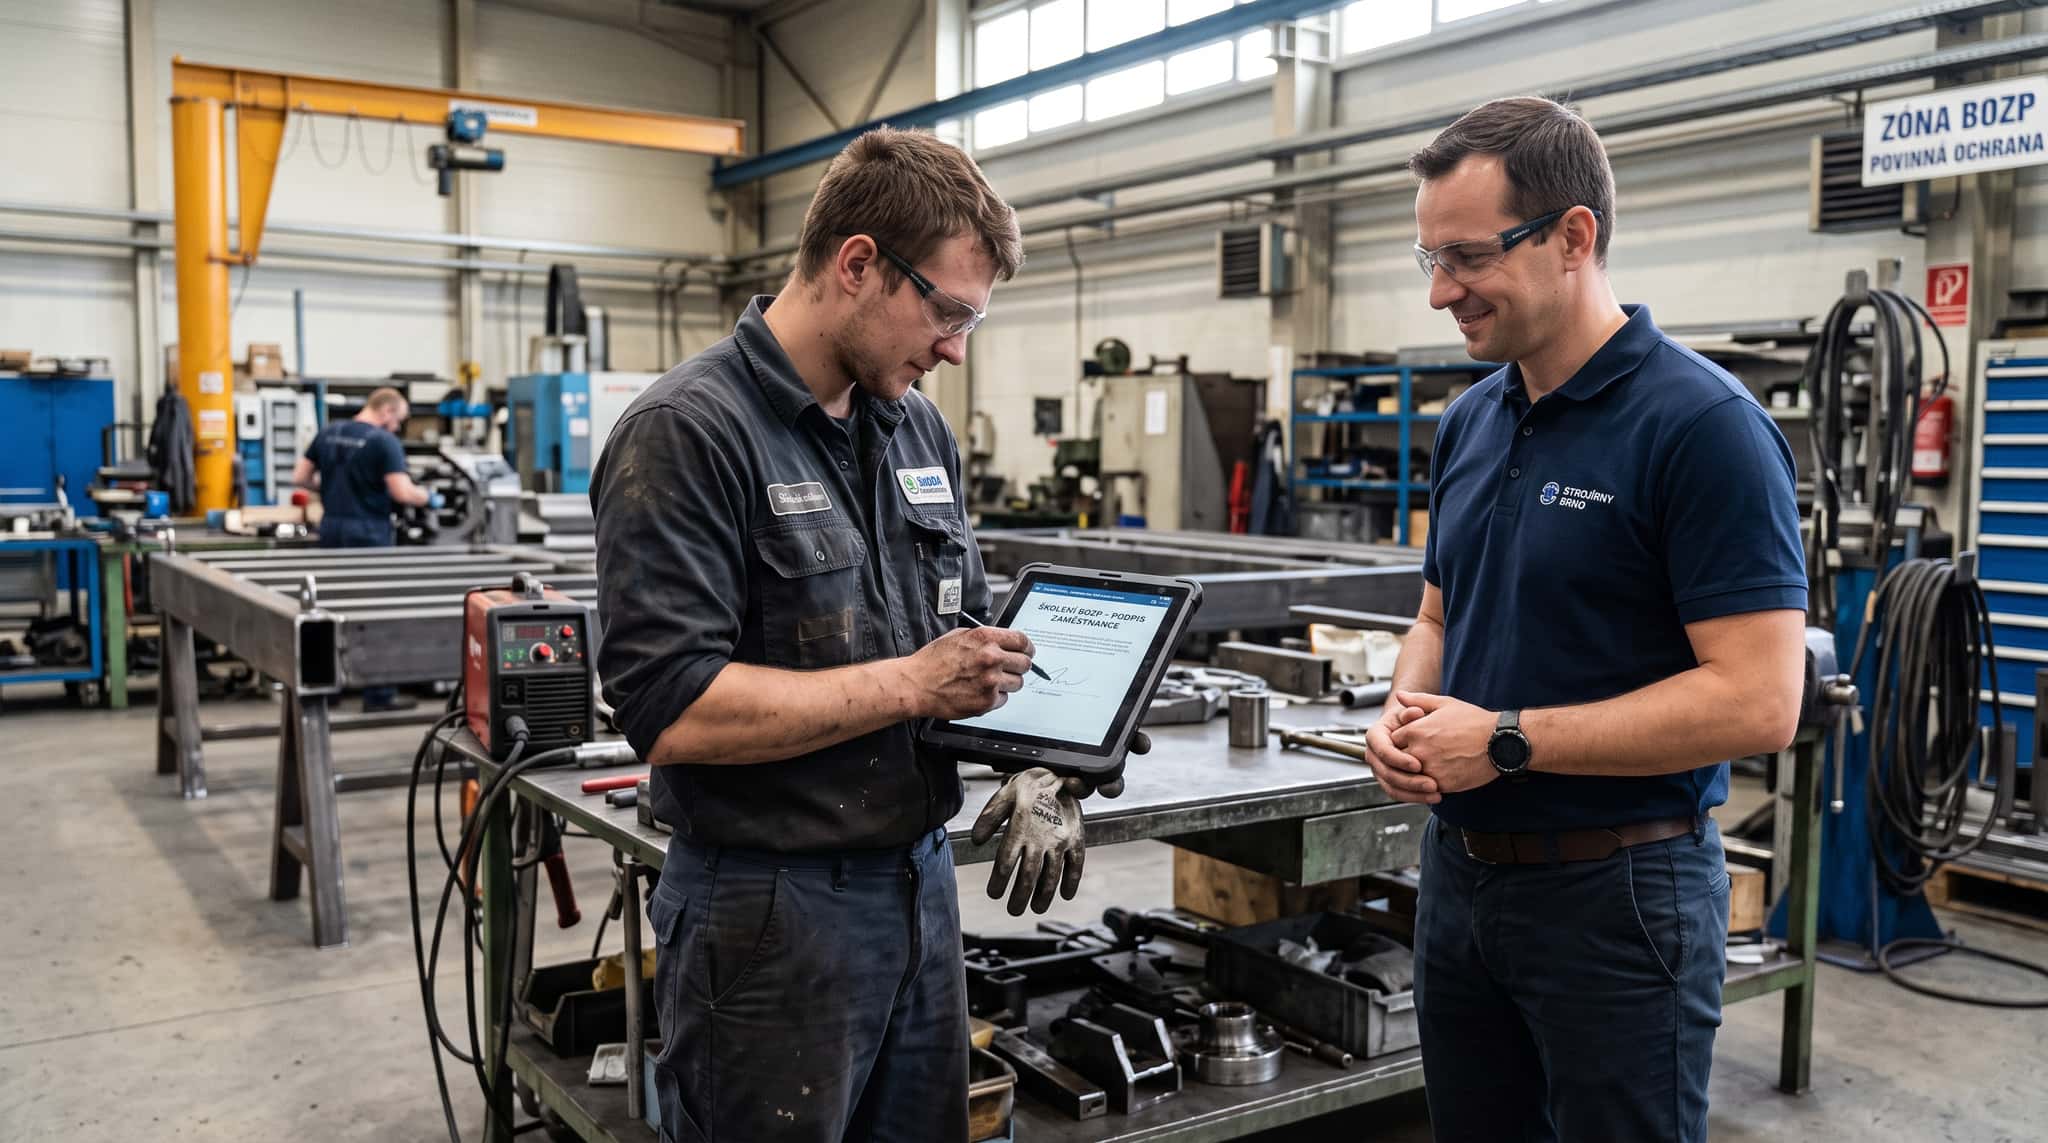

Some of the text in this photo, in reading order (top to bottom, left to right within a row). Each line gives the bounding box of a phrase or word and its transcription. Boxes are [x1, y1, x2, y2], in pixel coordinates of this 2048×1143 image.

[1881, 92, 2036, 142] ZÓNA BOZP
[1870, 132, 2044, 173] POVINNÁ OCHRANA
[1559, 497, 1586, 510] BRNO
[1562, 486, 1614, 504] STROJÍRNY
[1037, 602, 1077, 614] ŠKOLENÍ
[1078, 607, 1103, 617] BOZP
[1111, 612, 1147, 623] PODPIS
[1050, 614, 1120, 629] ZAMĚSTNANCE
